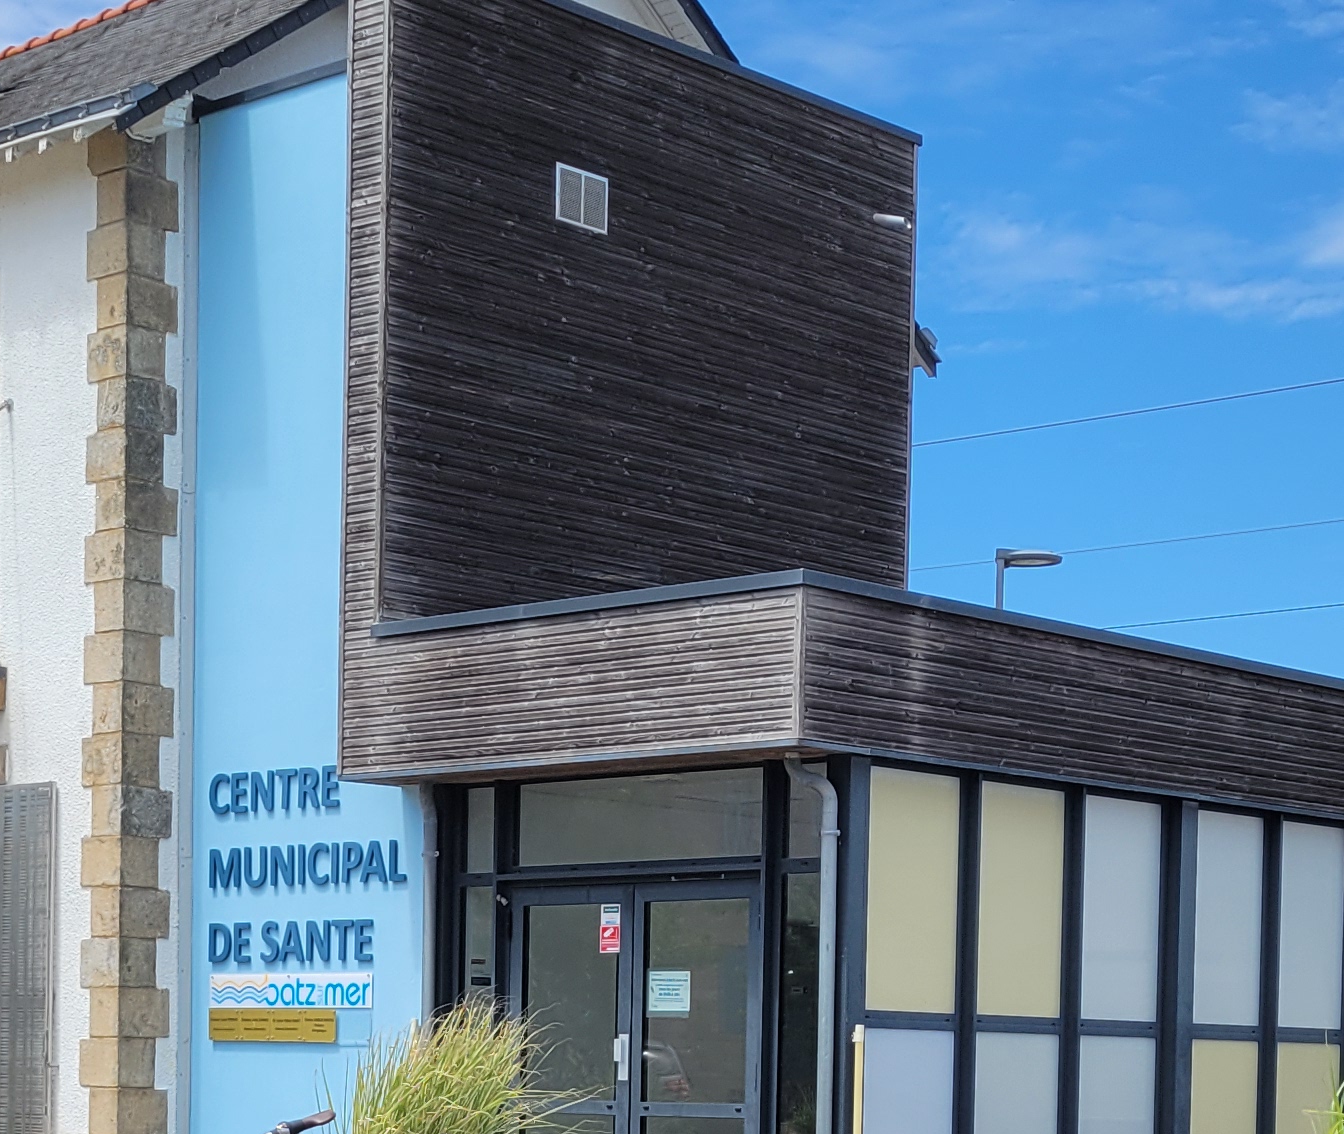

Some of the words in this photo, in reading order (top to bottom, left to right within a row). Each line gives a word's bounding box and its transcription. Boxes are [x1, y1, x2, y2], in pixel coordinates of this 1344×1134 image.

[209, 765, 340, 814] CENTRE
[209, 839, 407, 889] MUNICIPAL
[208, 921, 251, 963] DE
[260, 918, 374, 963] SANTE
[325, 982, 370, 1006] mer
